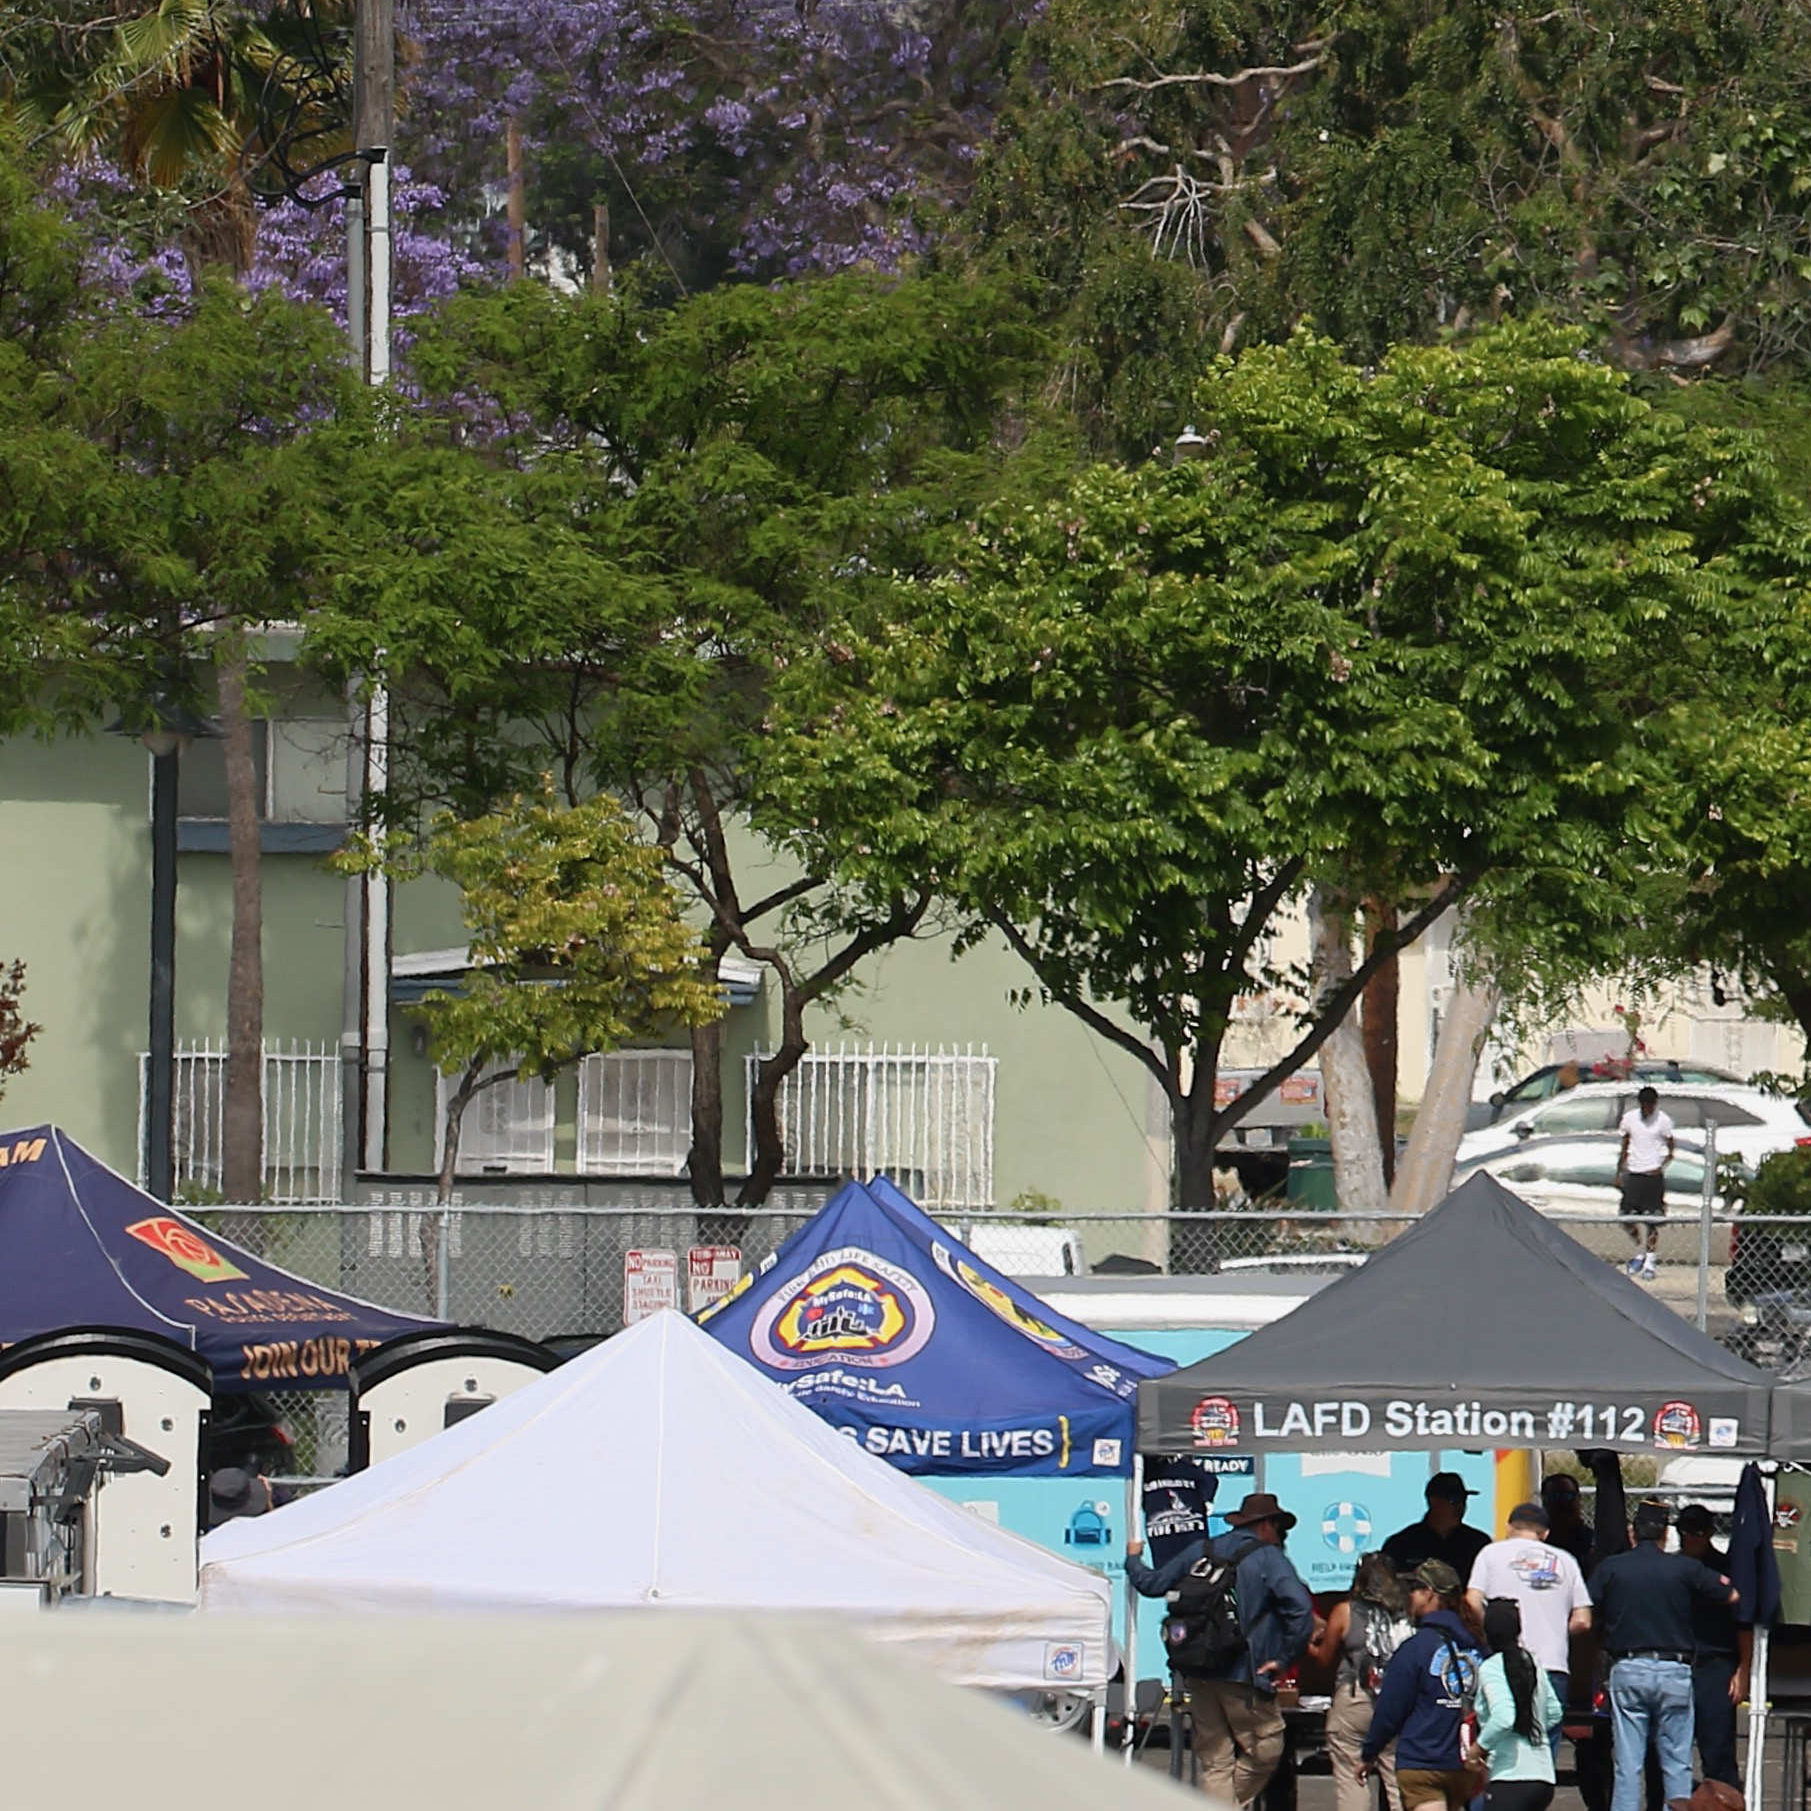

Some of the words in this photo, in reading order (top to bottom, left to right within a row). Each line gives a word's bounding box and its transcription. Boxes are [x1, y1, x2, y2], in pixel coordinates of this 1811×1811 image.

[628, 1254, 641, 1268] NO
[841, 1249, 871, 1264] LIFE
[693, 1260, 710, 1275] NO
[693, 1279, 736, 1290] PARKING
[240, 1340, 299, 1381] JOIN
[301, 1337, 350, 1376] OUR
[1253, 1400, 1371, 1440] LAFD
[1384, 1401, 1535, 1438] Station
[1547, 1402, 1646, 1442] #112
[864, 1426, 952, 1457] SAVE
[961, 1429, 1055, 1458] LIVES
[1203, 1459, 1250, 1474] READY
